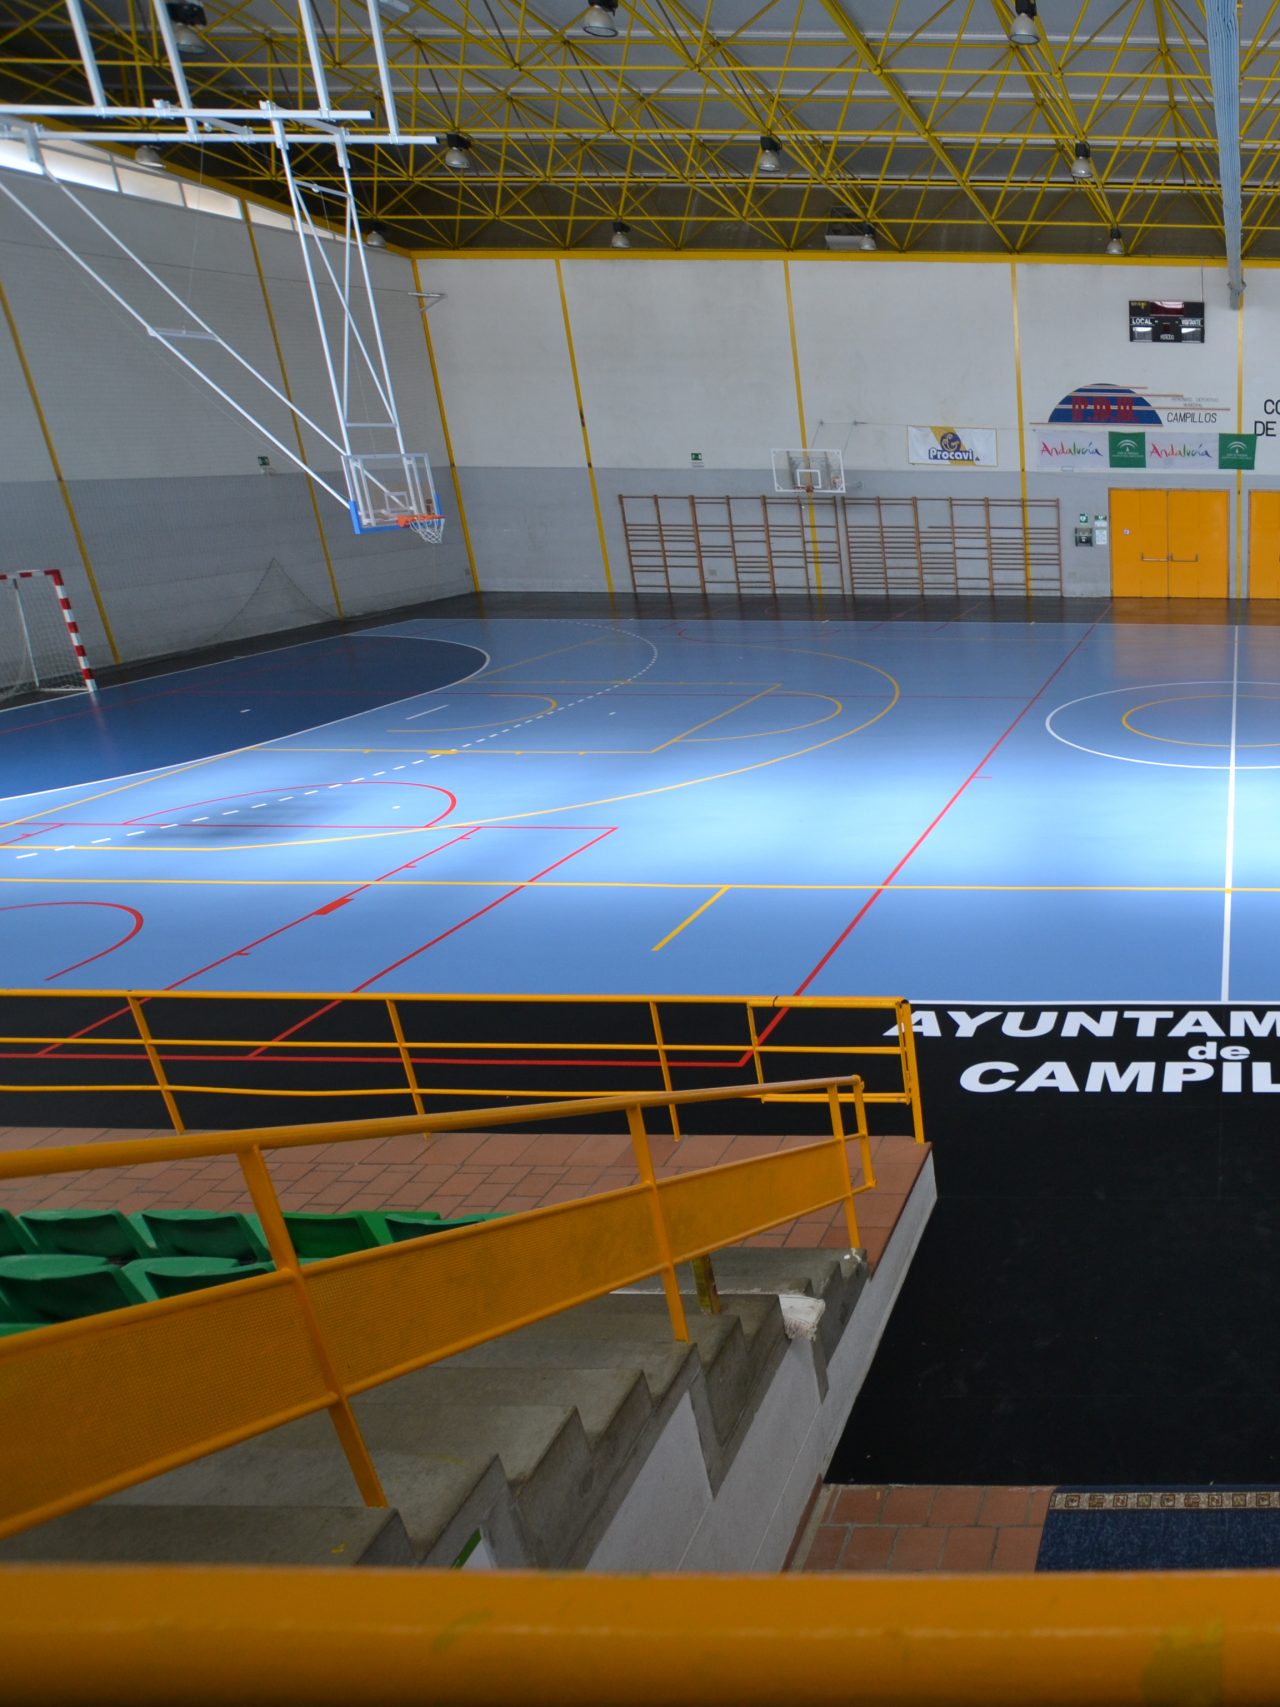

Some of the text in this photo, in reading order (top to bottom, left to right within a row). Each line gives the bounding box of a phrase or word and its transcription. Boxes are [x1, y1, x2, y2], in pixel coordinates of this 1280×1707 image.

[1166, 411, 1218, 424] CAMPILLOS
[1254, 420, 1277, 437] DE
[928, 448, 974, 461] Procavi
[1040, 441, 1104, 457] Andalucía
[1150, 443, 1213, 459] Andalucía
[1187, 1041, 1251, 1061] de
